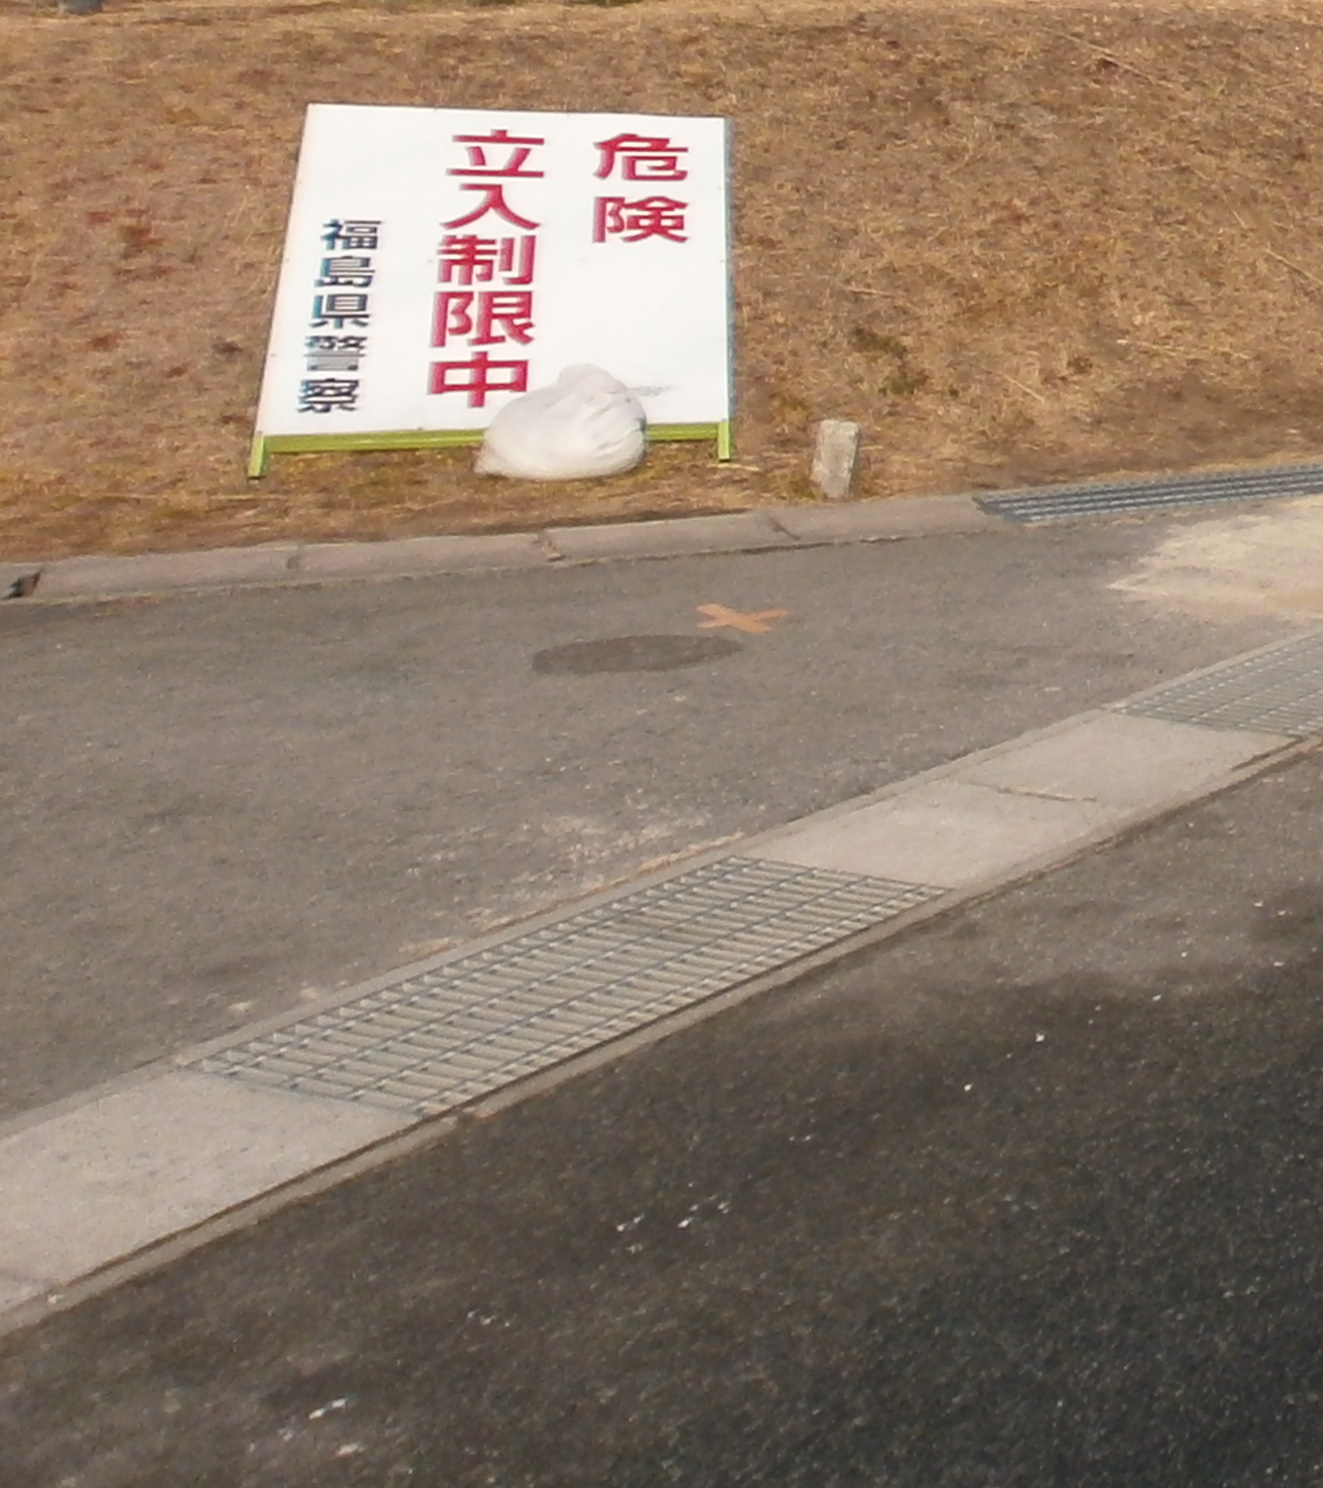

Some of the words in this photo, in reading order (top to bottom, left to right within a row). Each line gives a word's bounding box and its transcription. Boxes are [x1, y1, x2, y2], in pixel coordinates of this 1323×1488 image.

[427, 129, 547, 408] 立入制限中
[593, 132, 690, 244] 危険
[297, 218, 382, 415] 福島県警察
